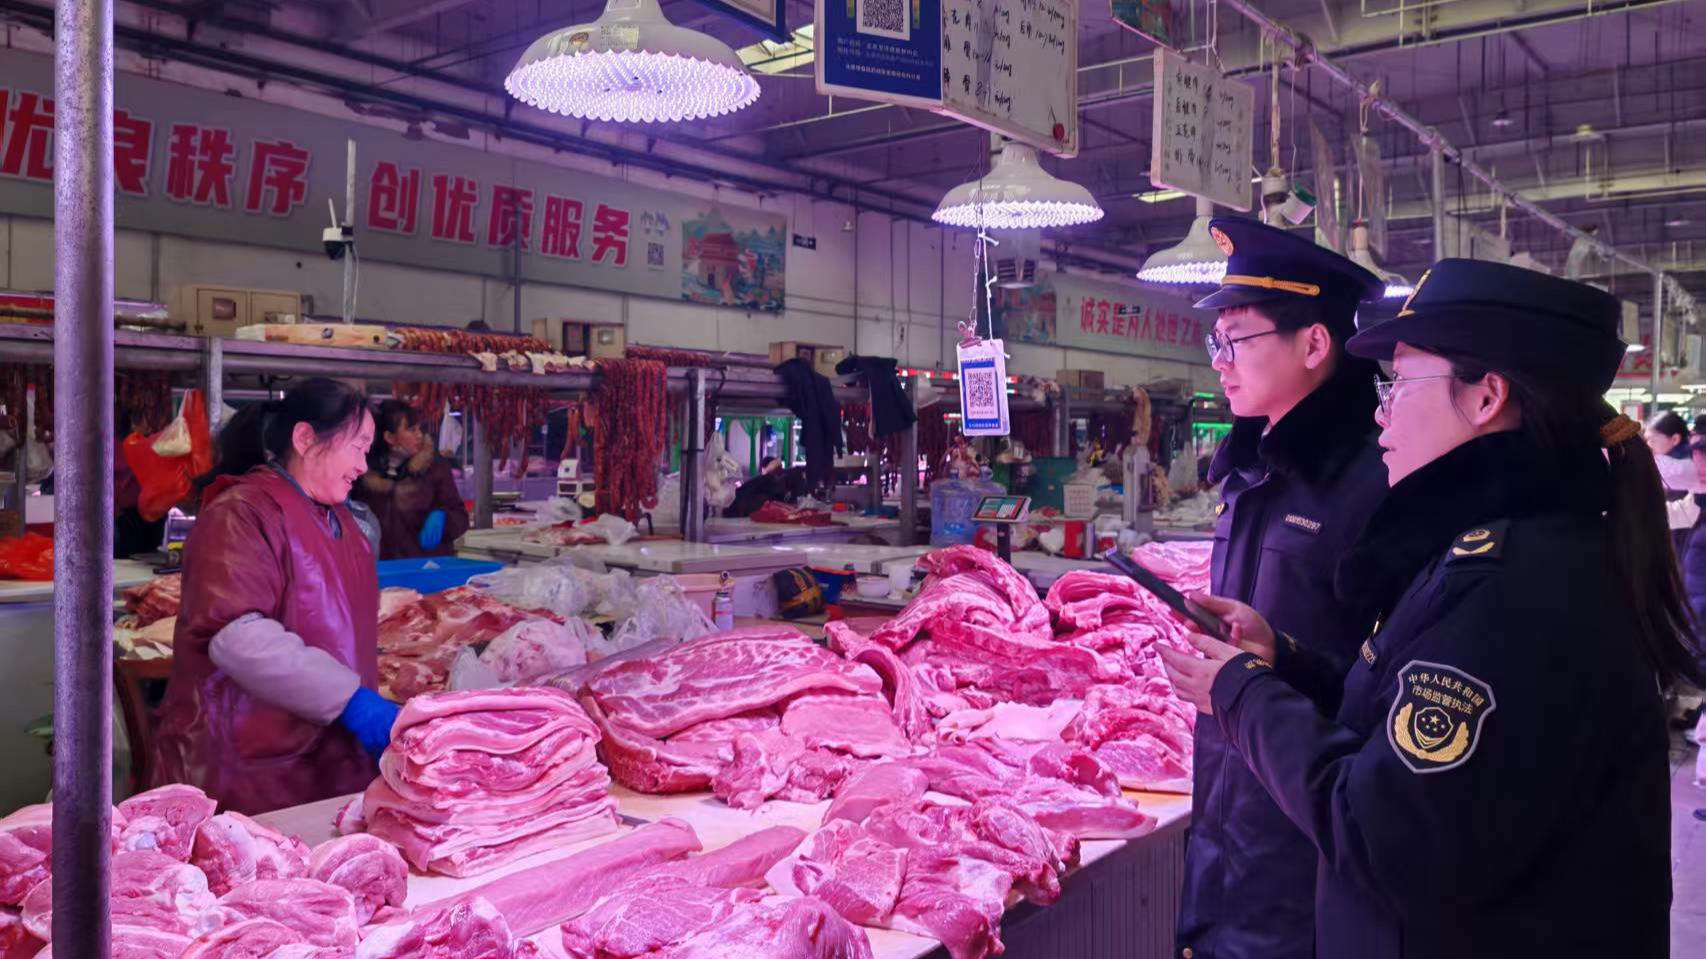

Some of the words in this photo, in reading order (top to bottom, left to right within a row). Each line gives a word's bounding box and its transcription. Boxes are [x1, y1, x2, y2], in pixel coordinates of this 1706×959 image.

[367, 160, 631, 268] 创优质服务
[1408, 671, 1485, 708] 中华人民共和国
[1411, 684, 1474, 716] 市场监管执法
